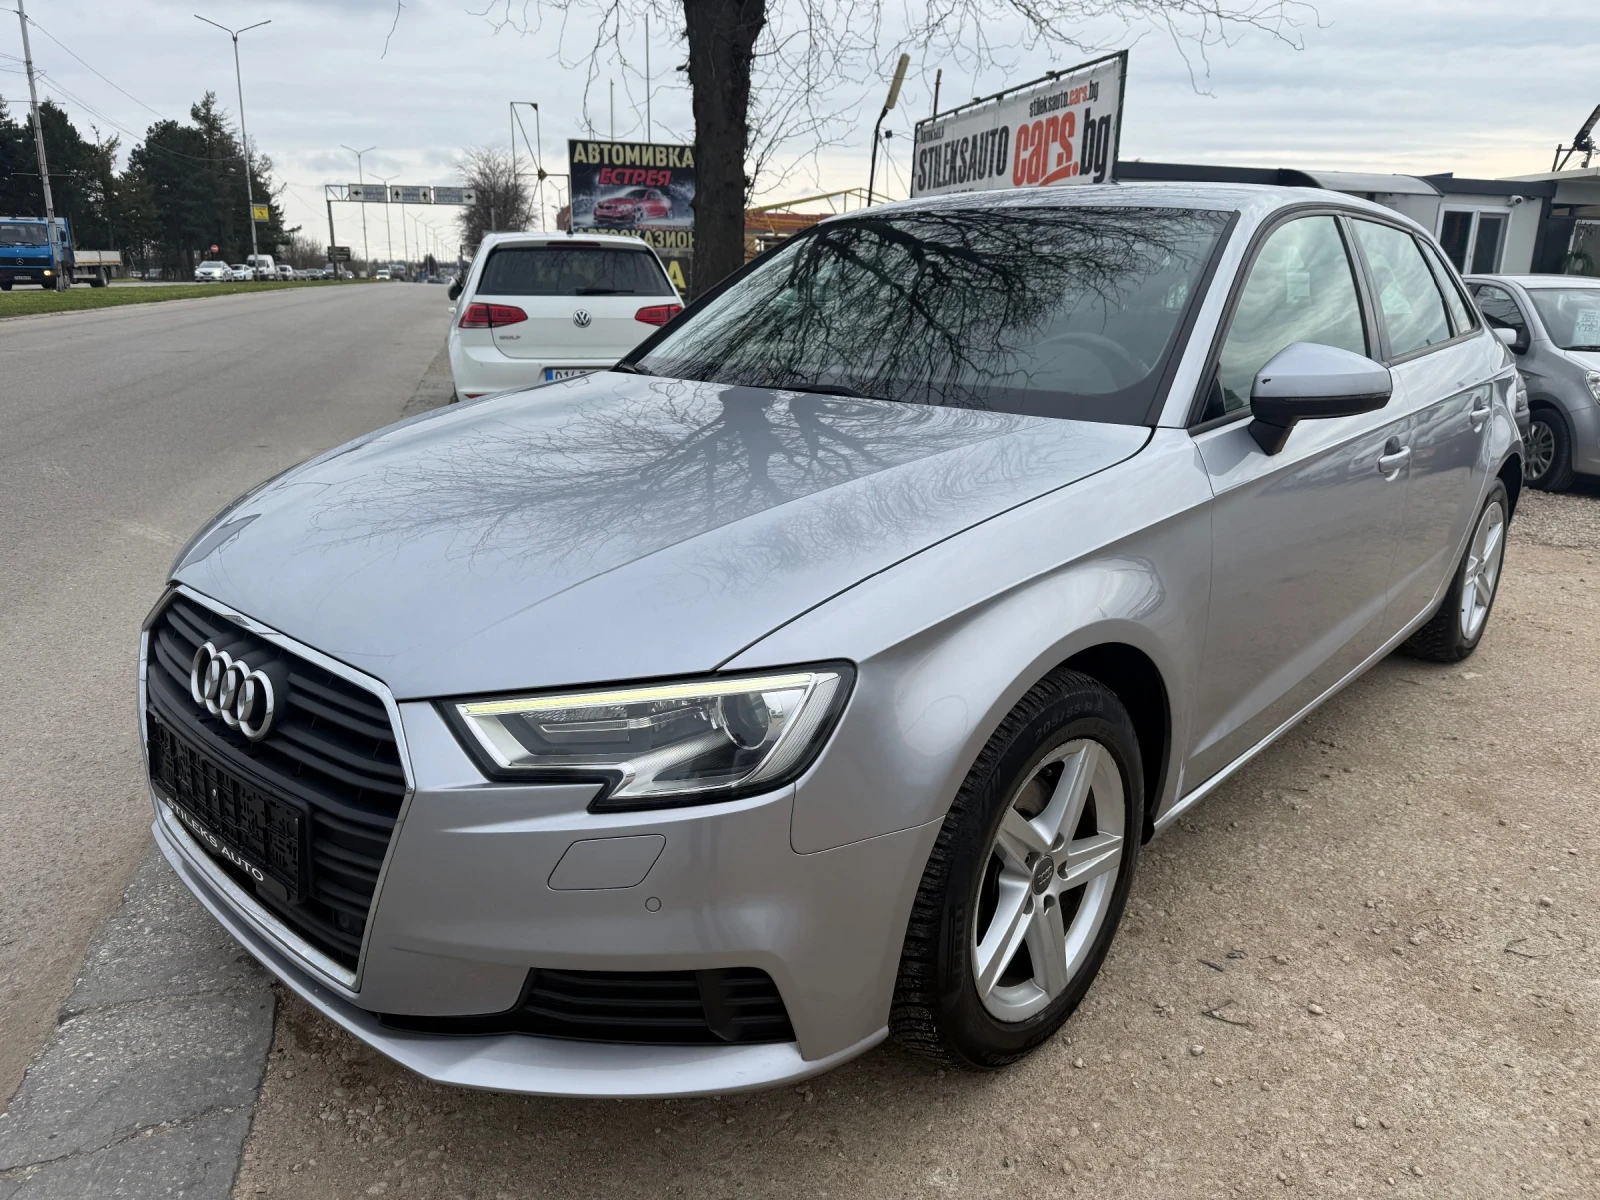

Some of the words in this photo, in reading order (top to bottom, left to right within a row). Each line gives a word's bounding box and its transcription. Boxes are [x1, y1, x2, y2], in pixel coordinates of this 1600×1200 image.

[1029, 80, 1099, 118] stileksauto.cars.bg
[573, 142, 695, 168] АВТОМИВКА
[917, 125, 1010, 191] STILEKSAUTO
[598, 167, 672, 187] ЕСТРЕЯ
[166, 797, 218, 848] STILEKS
[221, 846, 264, 881] AUTO
